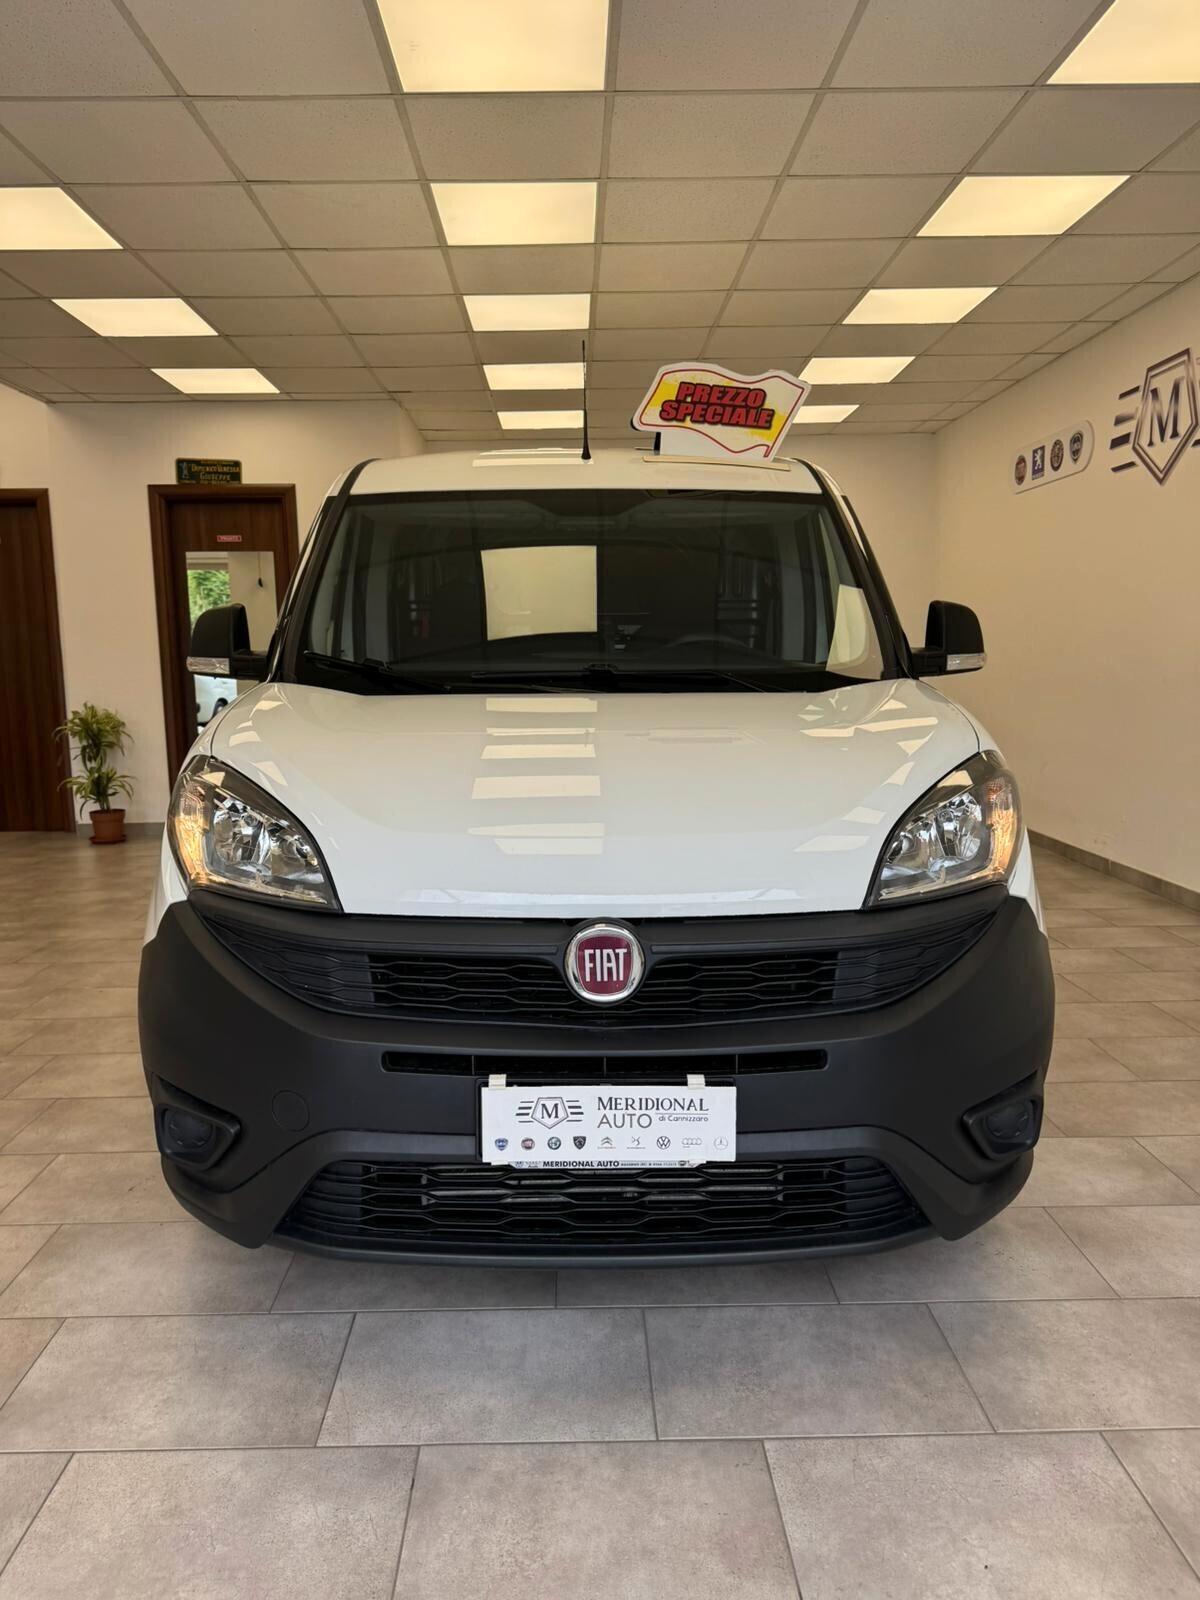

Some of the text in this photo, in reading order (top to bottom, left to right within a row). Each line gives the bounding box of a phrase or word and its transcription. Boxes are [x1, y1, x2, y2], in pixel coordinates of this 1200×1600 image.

[676, 383, 766, 407] PREZZO
[660, 400, 774, 429] SPECIALE
[1147, 375, 1186, 447] M
[584, 948, 628, 982] FIAT
[540, 1103, 560, 1119] M
[597, 1096, 709, 1112] MERIDIONAL
[597, 1113, 652, 1129] AUTO
[658, 1114, 709, 1122] di Cannizzaro
